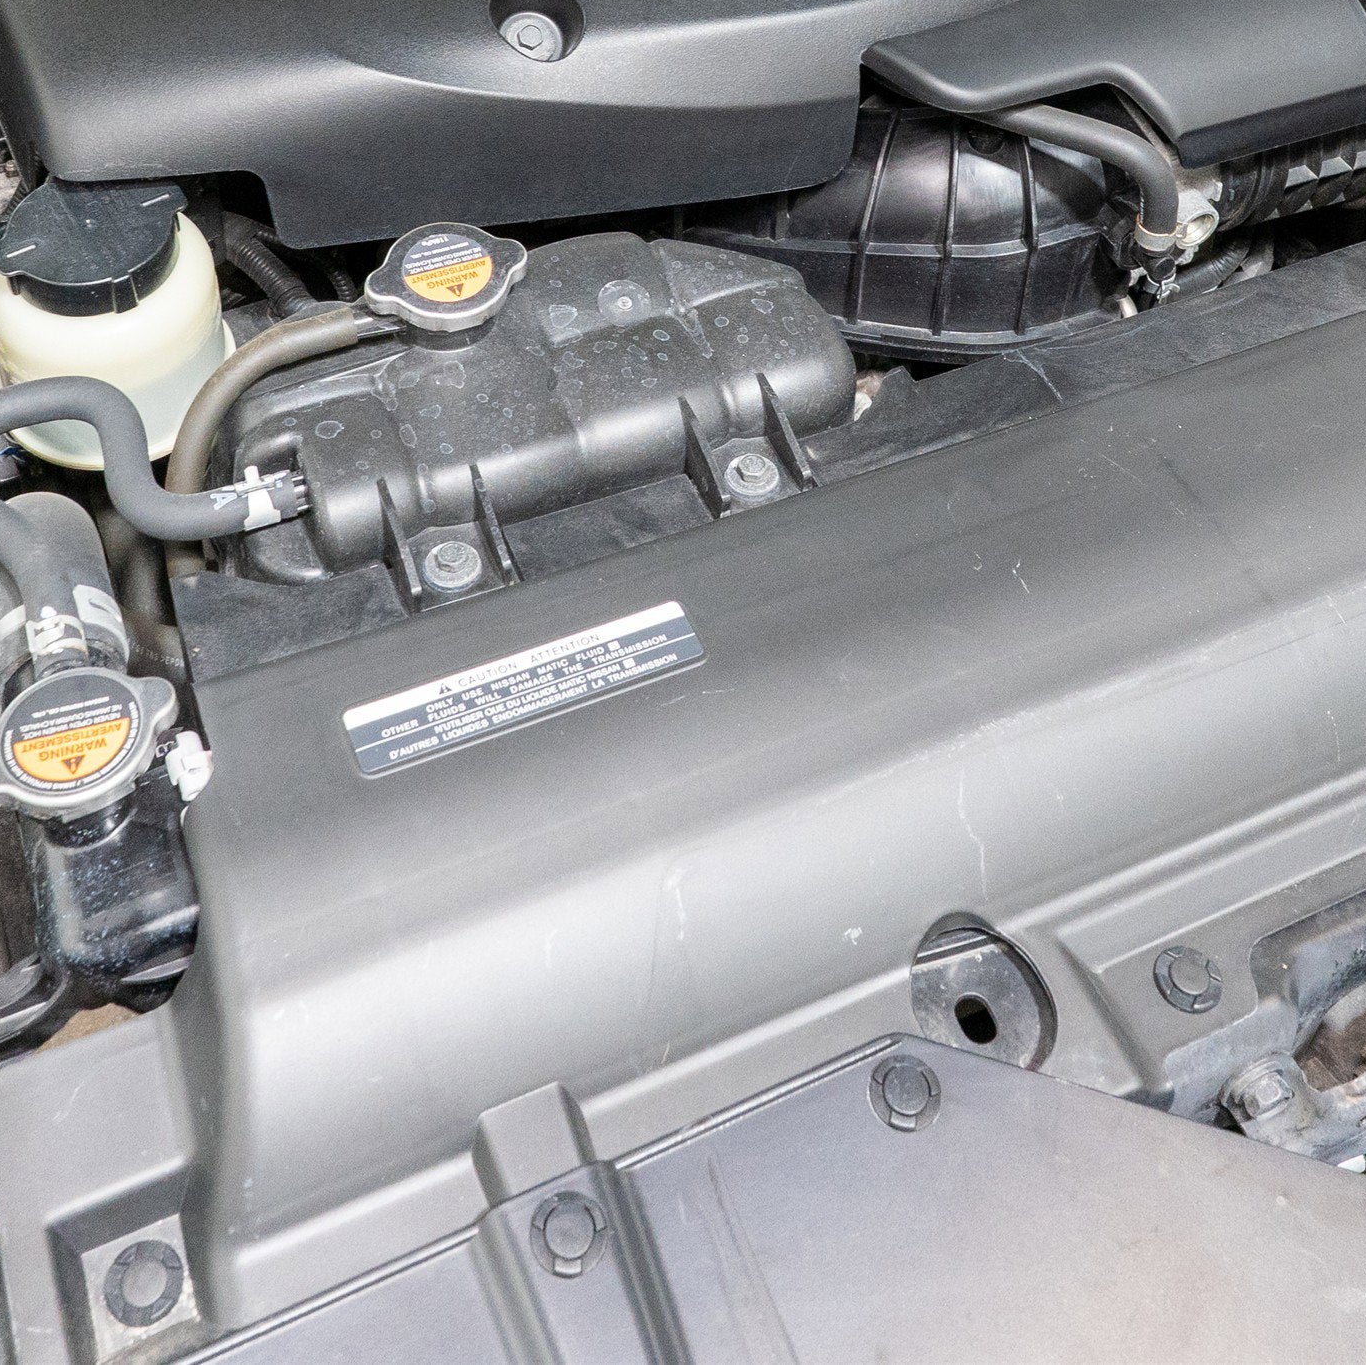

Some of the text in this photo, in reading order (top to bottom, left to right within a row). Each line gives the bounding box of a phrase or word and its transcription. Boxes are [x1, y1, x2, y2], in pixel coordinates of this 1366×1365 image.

[411, 259, 485, 283] AVERTISSEMENT
[426, 270, 478, 289] WARNING
[380, 718, 420, 738] OTHER
[426, 702, 467, 722] FLUIDS
[473, 690, 502, 706] WILL
[508, 672, 555, 694] DAMAGE
[561, 662, 584, 675] THE
[591, 633, 668, 665] TRANSMISSION
[424, 696, 455, 713] ONLY
[460, 687, 484, 701] USE
[489, 671, 531, 691] NISSAN
[535, 657, 570, 675] MATIC
[573, 645, 606, 662] FLUID
[457, 661, 518, 688] CAUTION
[528, 633, 600, 663] ATTENTION
[388, 735, 440, 761] D'AUTRES
[440, 717, 489, 742] LIQUIDES
[490, 683, 589, 724] ENDOMMAGERAIENT
[590, 678, 605, 689] LA
[606, 652, 678, 683] TRANSMISSION
[433, 710, 485, 735] N'UTILISER
[483, 702, 506, 717] QUE
[504, 697, 521, 709] DU
[519, 684, 558, 704] LIQUIDE
[556, 674, 587, 691] MATIC
[585, 662, 621, 680] NISSAN
[20, 722, 121, 753] AVERTISSEMENT
[38, 737, 106, 761] WARNING
